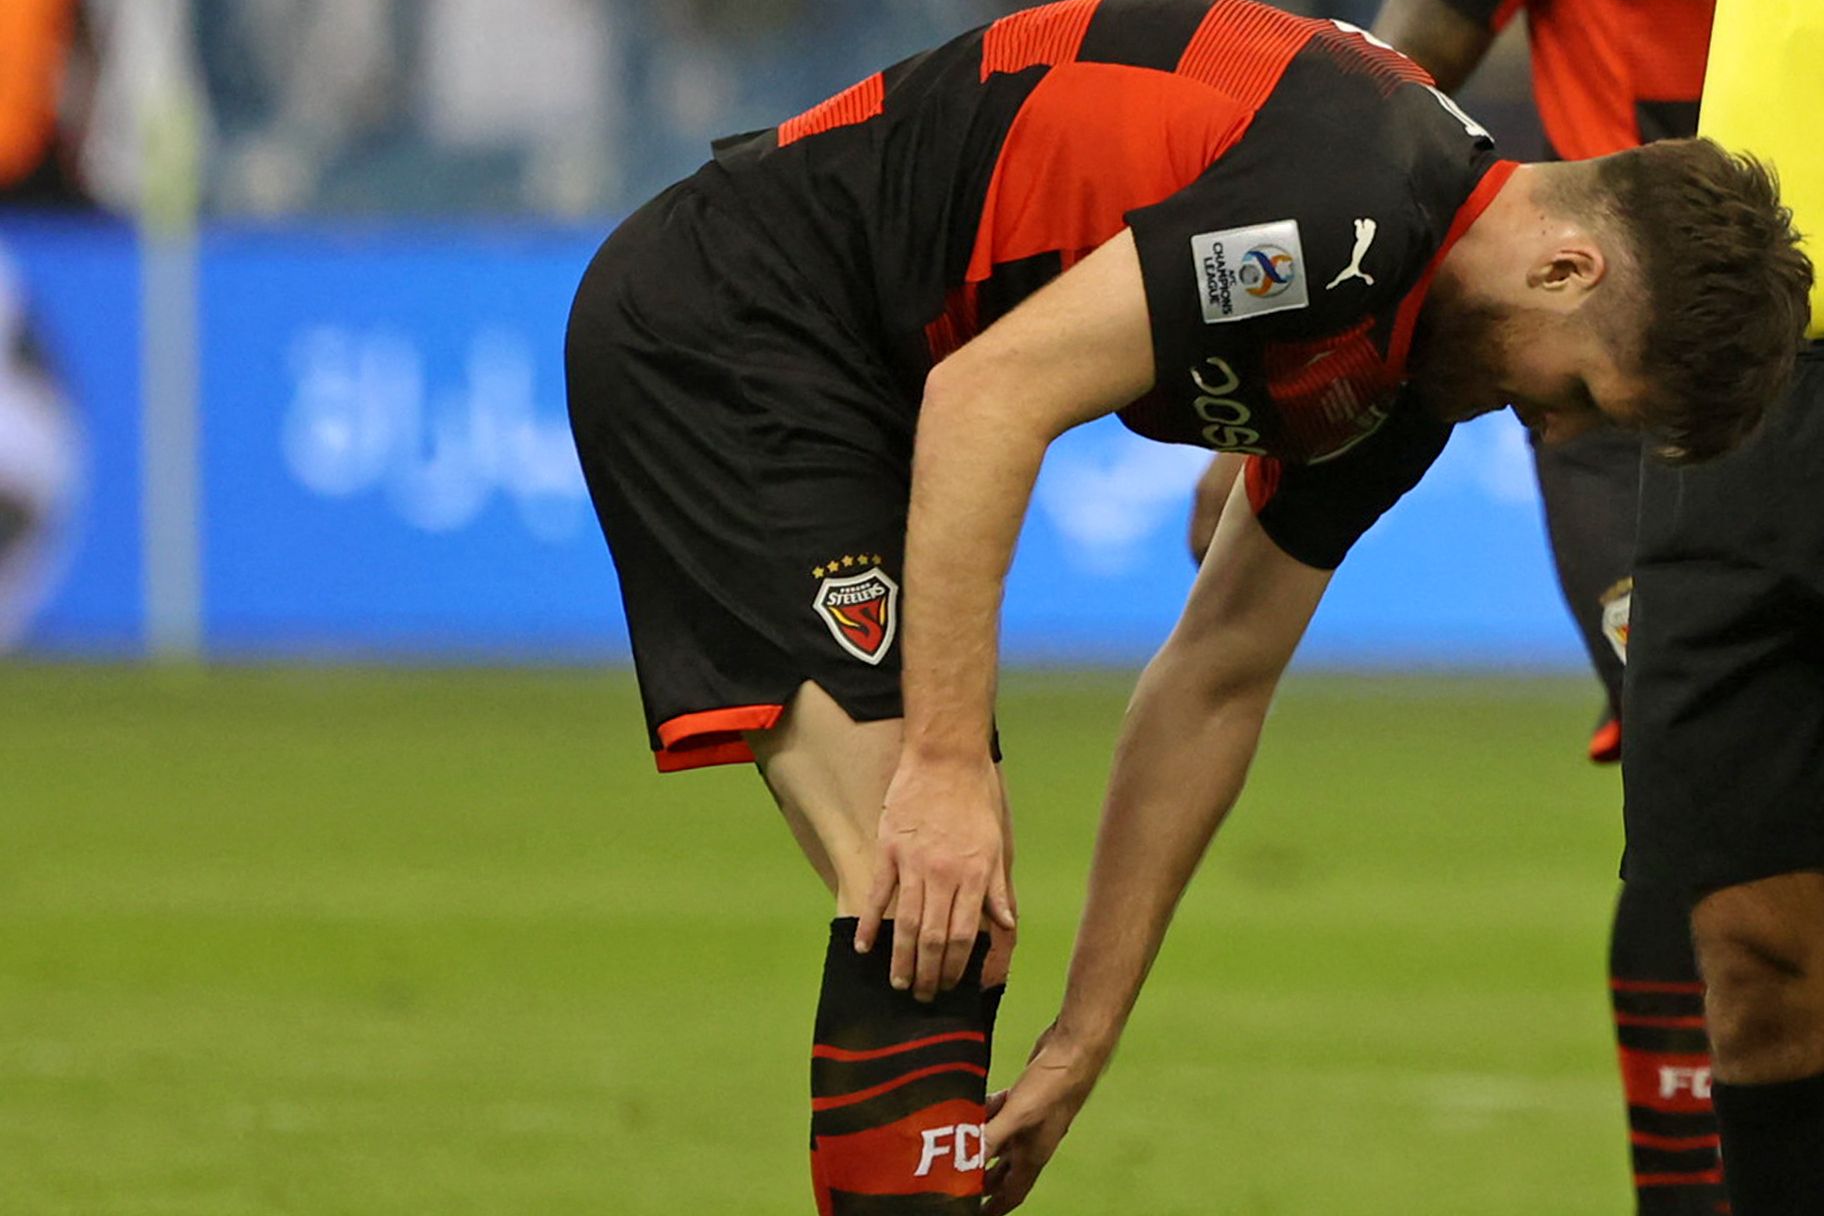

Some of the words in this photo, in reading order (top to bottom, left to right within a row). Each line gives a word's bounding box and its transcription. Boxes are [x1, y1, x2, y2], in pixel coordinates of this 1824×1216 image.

[1204, 256, 1220, 305] LEAGUE
[1212, 242, 1232, 315] CHAMPIONS
[914, 1122, 986, 1177] FC
